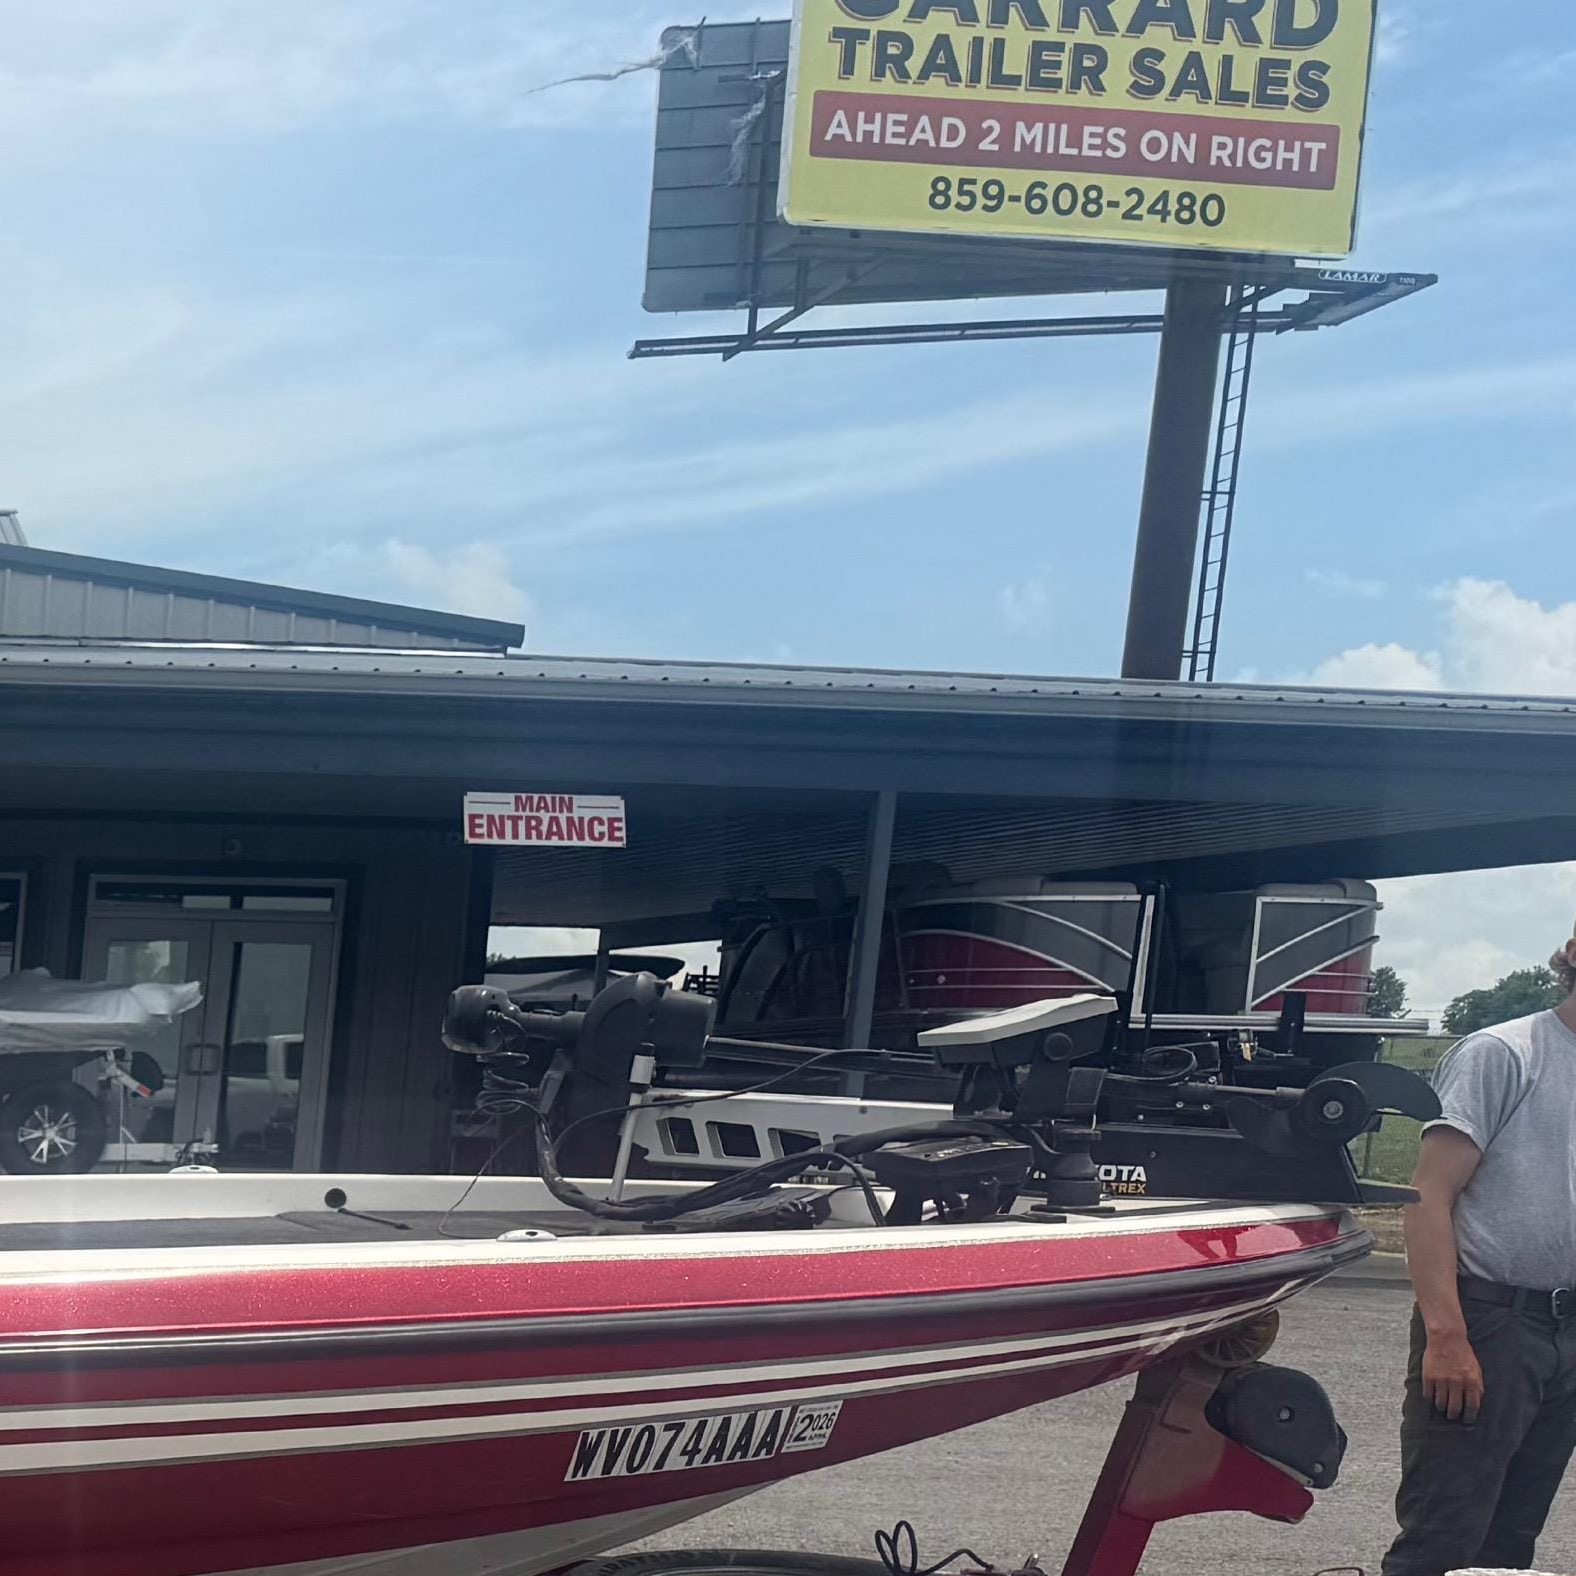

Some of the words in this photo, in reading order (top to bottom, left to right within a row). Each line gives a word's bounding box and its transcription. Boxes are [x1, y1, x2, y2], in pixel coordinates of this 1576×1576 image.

[829, 26, 1108, 96] TRAILER
[1126, 46, 1332, 111] SALES
[823, 109, 967, 150] AHEAD
[976, 118, 1001, 152] 2
[1013, 120, 1128, 159] MILES
[1139, 129, 1197, 165] ON
[1209, 136, 1327, 174] RIGHT
[928, 175, 1226, 228] 859-608-2480
[514, 795, 574, 814] MAIN
[467, 813, 625, 843] ENTRANCE
[1094, 1164, 1147, 1182] OTA
[1102, 1181, 1147, 1194] LTREX
